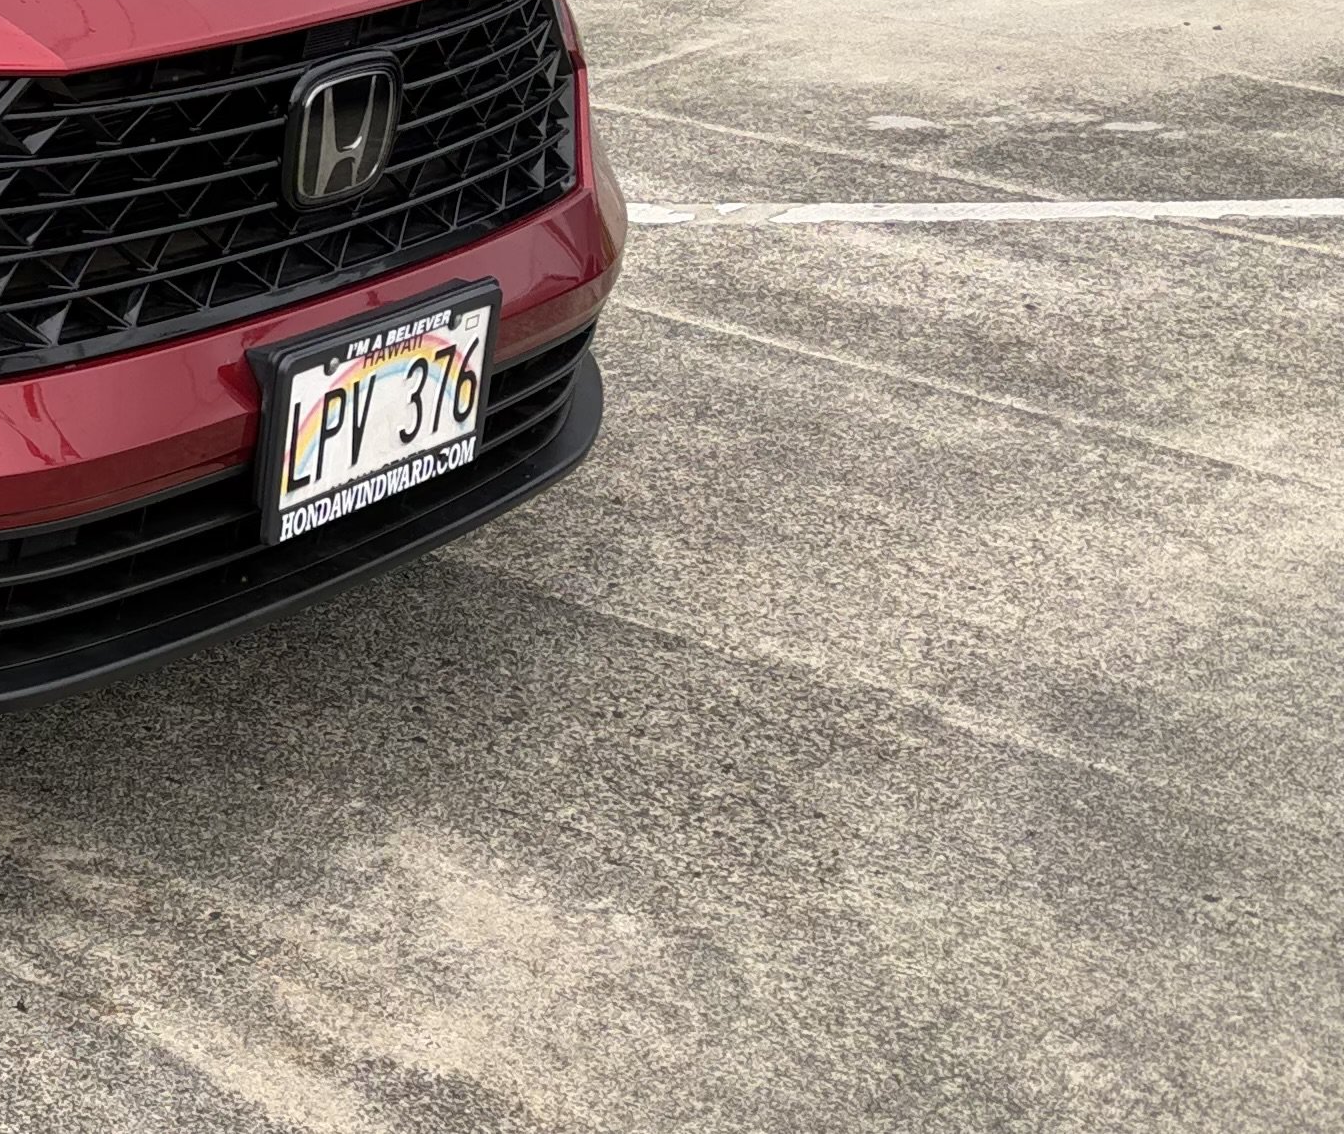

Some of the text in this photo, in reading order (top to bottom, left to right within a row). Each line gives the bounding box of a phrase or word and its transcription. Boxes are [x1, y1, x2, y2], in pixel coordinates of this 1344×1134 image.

[346, 309, 452, 360] I'M A BELIEVER
[285, 336, 480, 493] LPV 376
[280, 436, 477, 543] HONDAWINDWARD.COM
